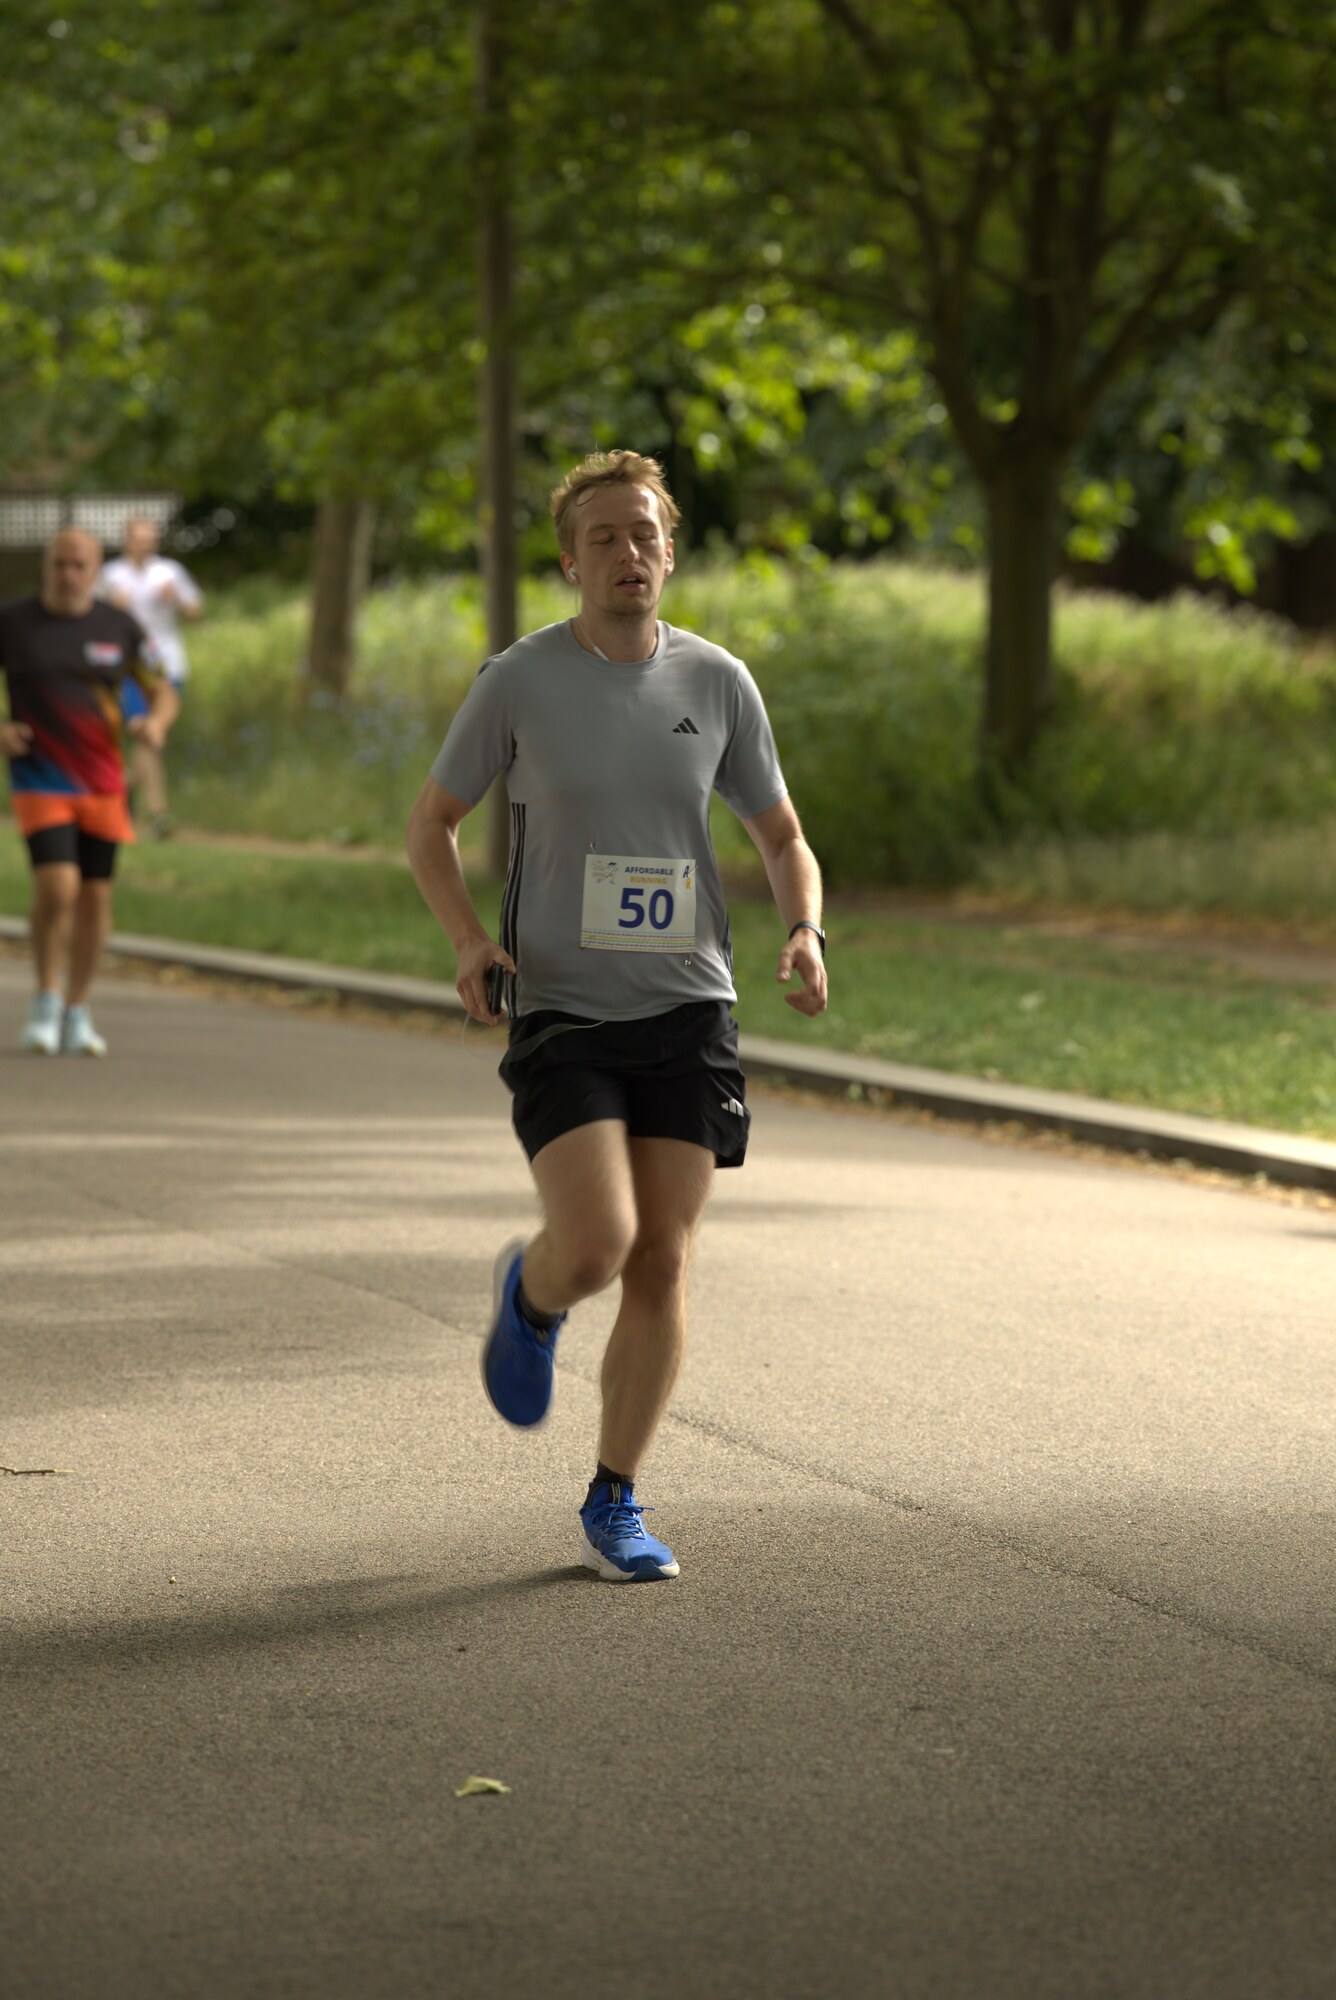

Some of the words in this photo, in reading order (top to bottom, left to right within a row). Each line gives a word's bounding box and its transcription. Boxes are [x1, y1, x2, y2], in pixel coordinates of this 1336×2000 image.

[624, 866, 674, 876] AFFORDABLE
[630, 876, 668, 885] RUNNING
[618, 887, 674, 930] 50
